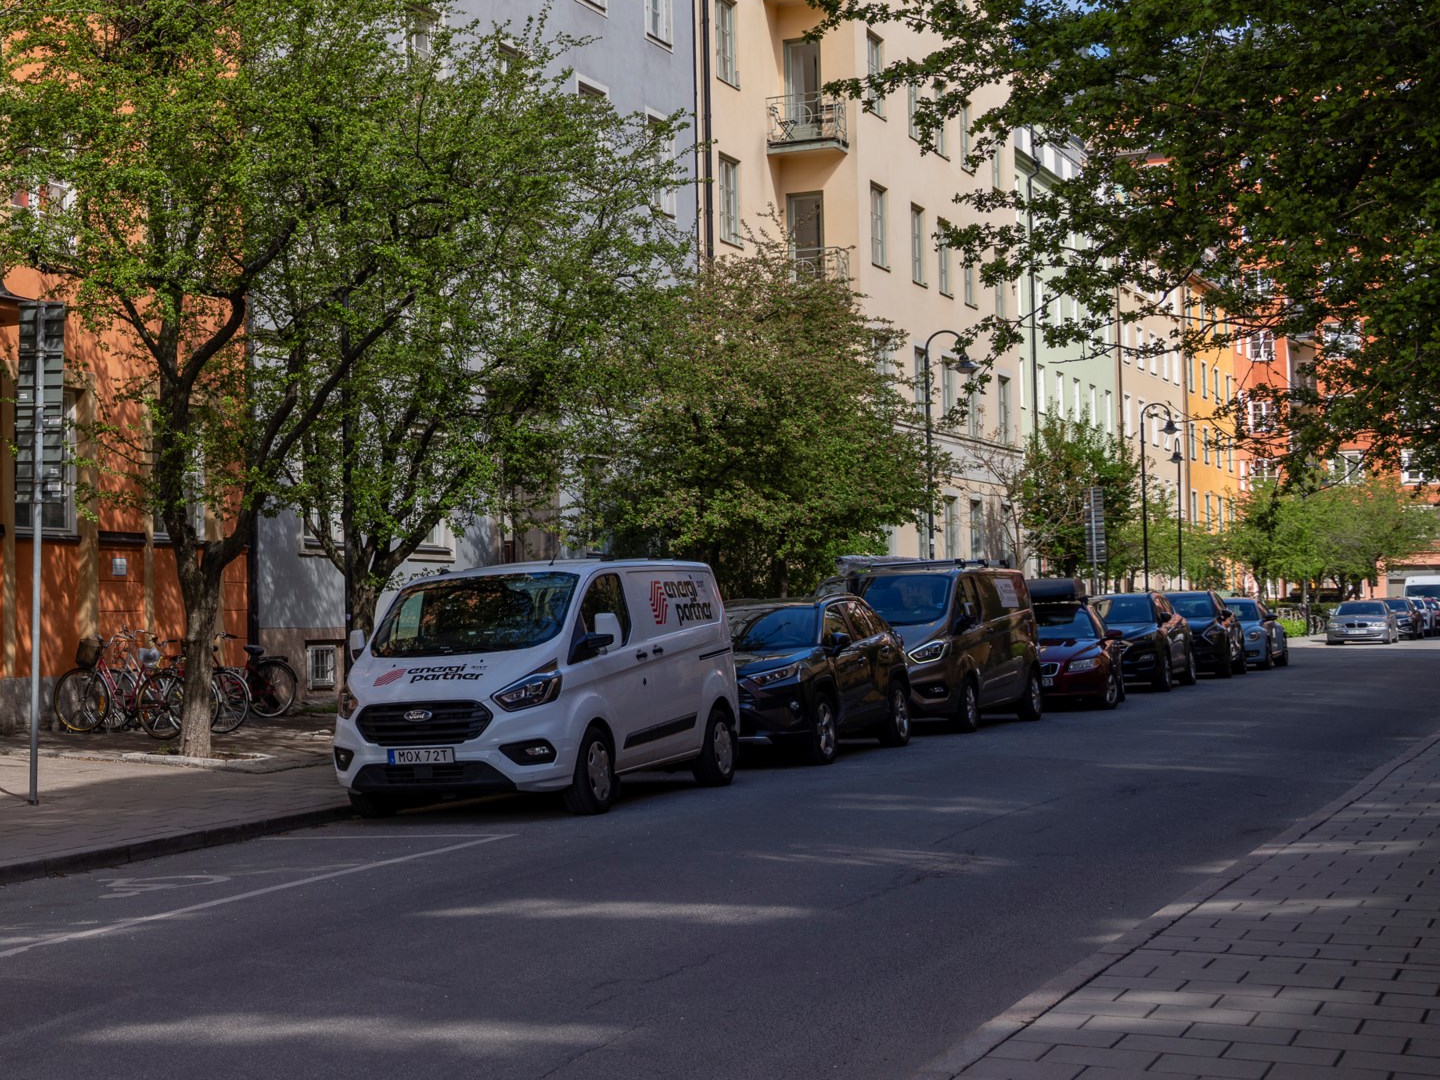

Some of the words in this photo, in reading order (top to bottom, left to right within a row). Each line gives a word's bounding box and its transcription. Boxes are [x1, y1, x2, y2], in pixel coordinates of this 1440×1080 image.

[407, 664, 466, 674] energi
[410, 673, 483, 683] partner
[408, 711, 425, 719] Ford
[398, 751, 421, 762] MOX
[424, 750, 447, 761] 72T
